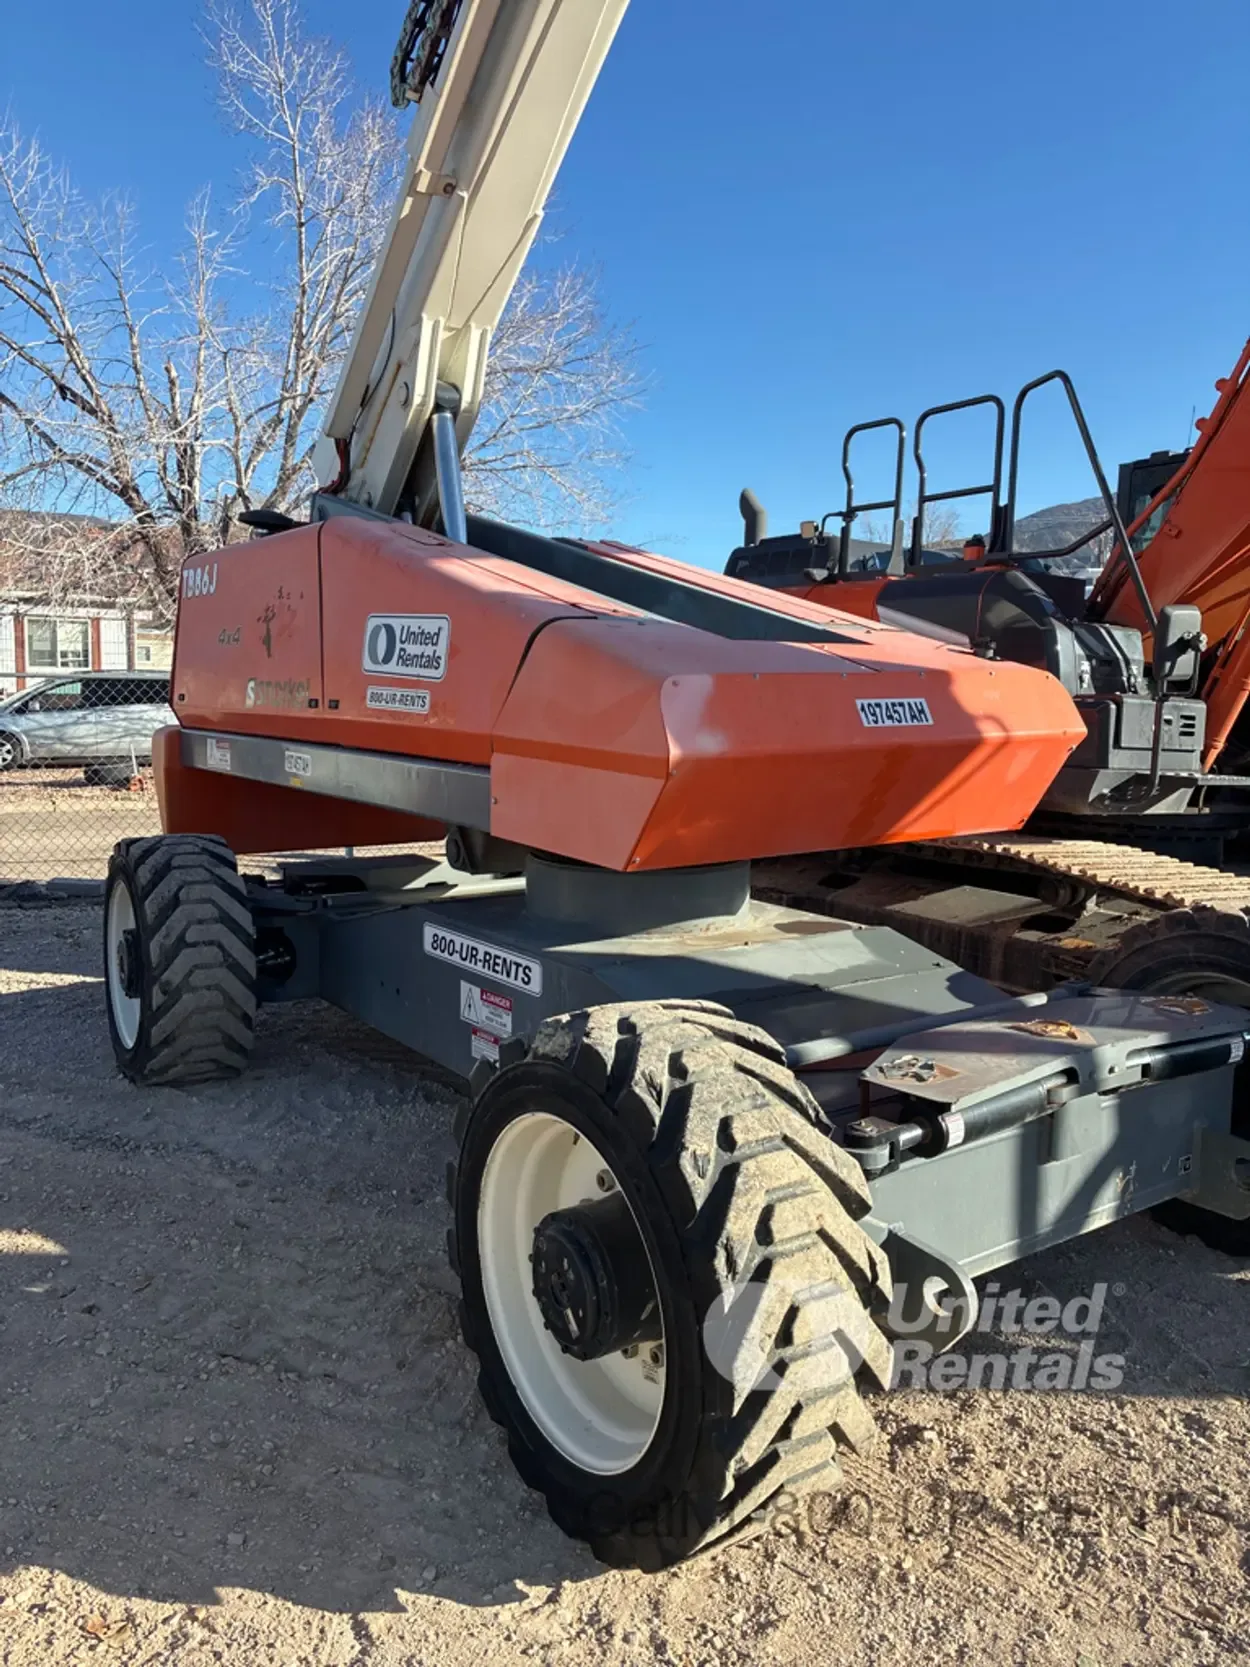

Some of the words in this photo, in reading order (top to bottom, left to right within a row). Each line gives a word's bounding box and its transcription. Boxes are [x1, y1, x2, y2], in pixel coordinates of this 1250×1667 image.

[218, 624, 242, 646] 4x4
[399, 624, 443, 647] United
[396, 647, 442, 670] Rentals
[368, 691, 428, 709] 800-UR-RENTS
[859, 701, 929, 725] 197457AH
[431, 933, 533, 986] 800-UR-RENTS
